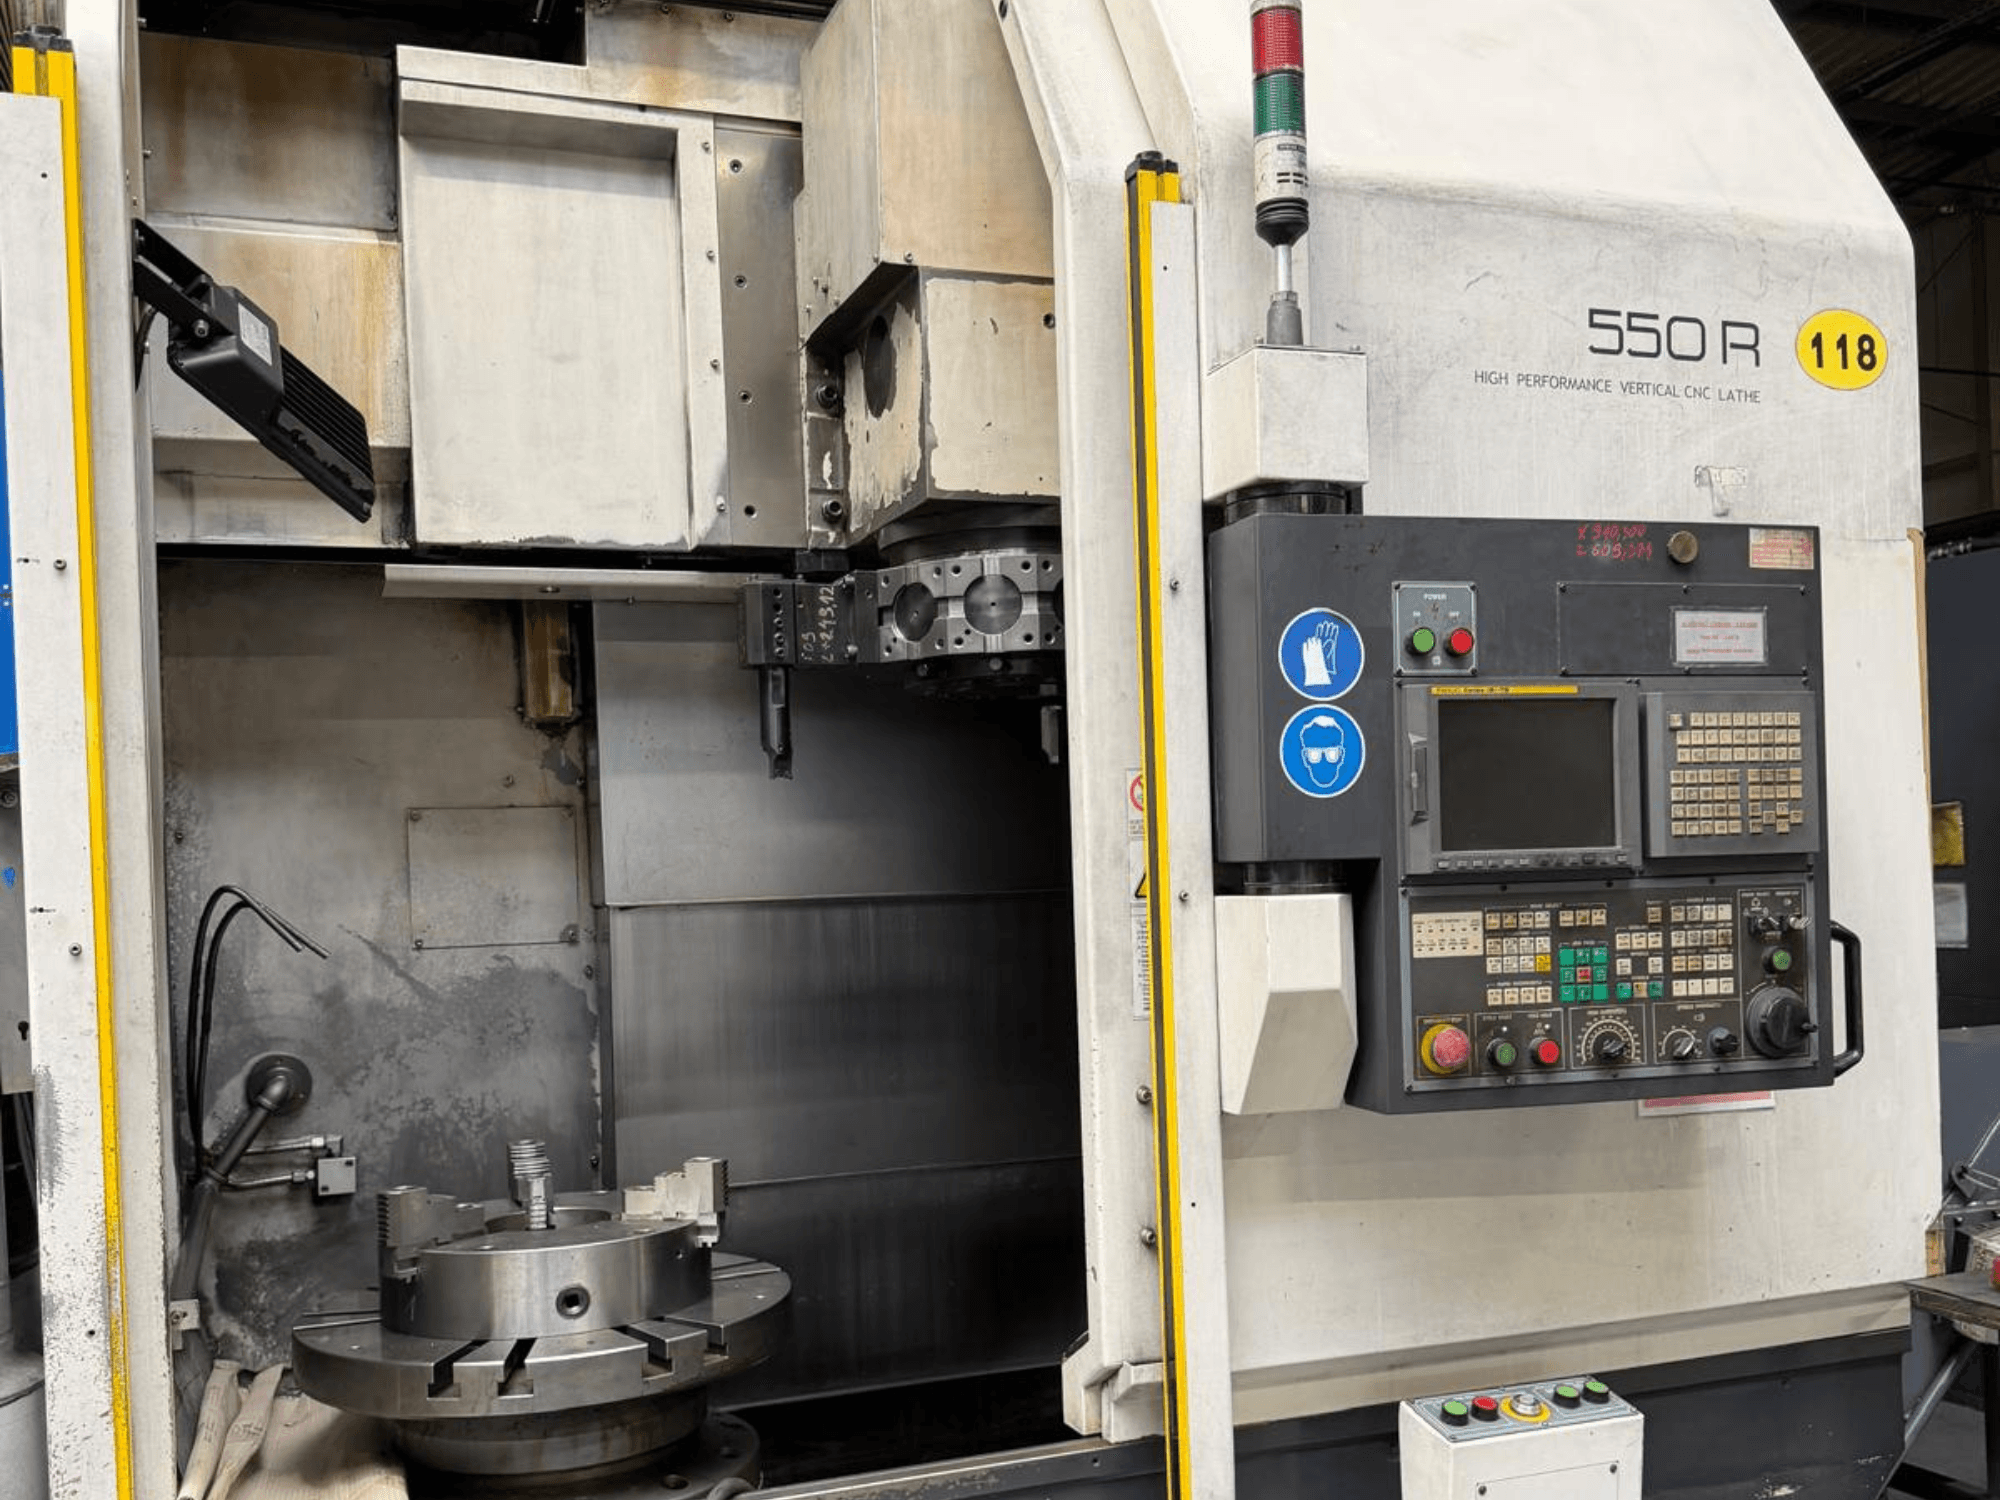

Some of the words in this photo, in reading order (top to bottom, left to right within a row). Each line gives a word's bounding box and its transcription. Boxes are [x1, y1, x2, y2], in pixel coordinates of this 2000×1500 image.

[1588, 308, 1706, 362] 550
[1721, 320, 1760, 367] R
[1811, 332, 1877, 372] 118
[1474, 370, 1509, 386] HIGH
[1517, 374, 1612, 393] PERFORMANCE
[1620, 380, 1680, 398] VERTICAL
[1684, 384, 1711, 400] CNC
[1718, 388, 1761, 403] LATHE
